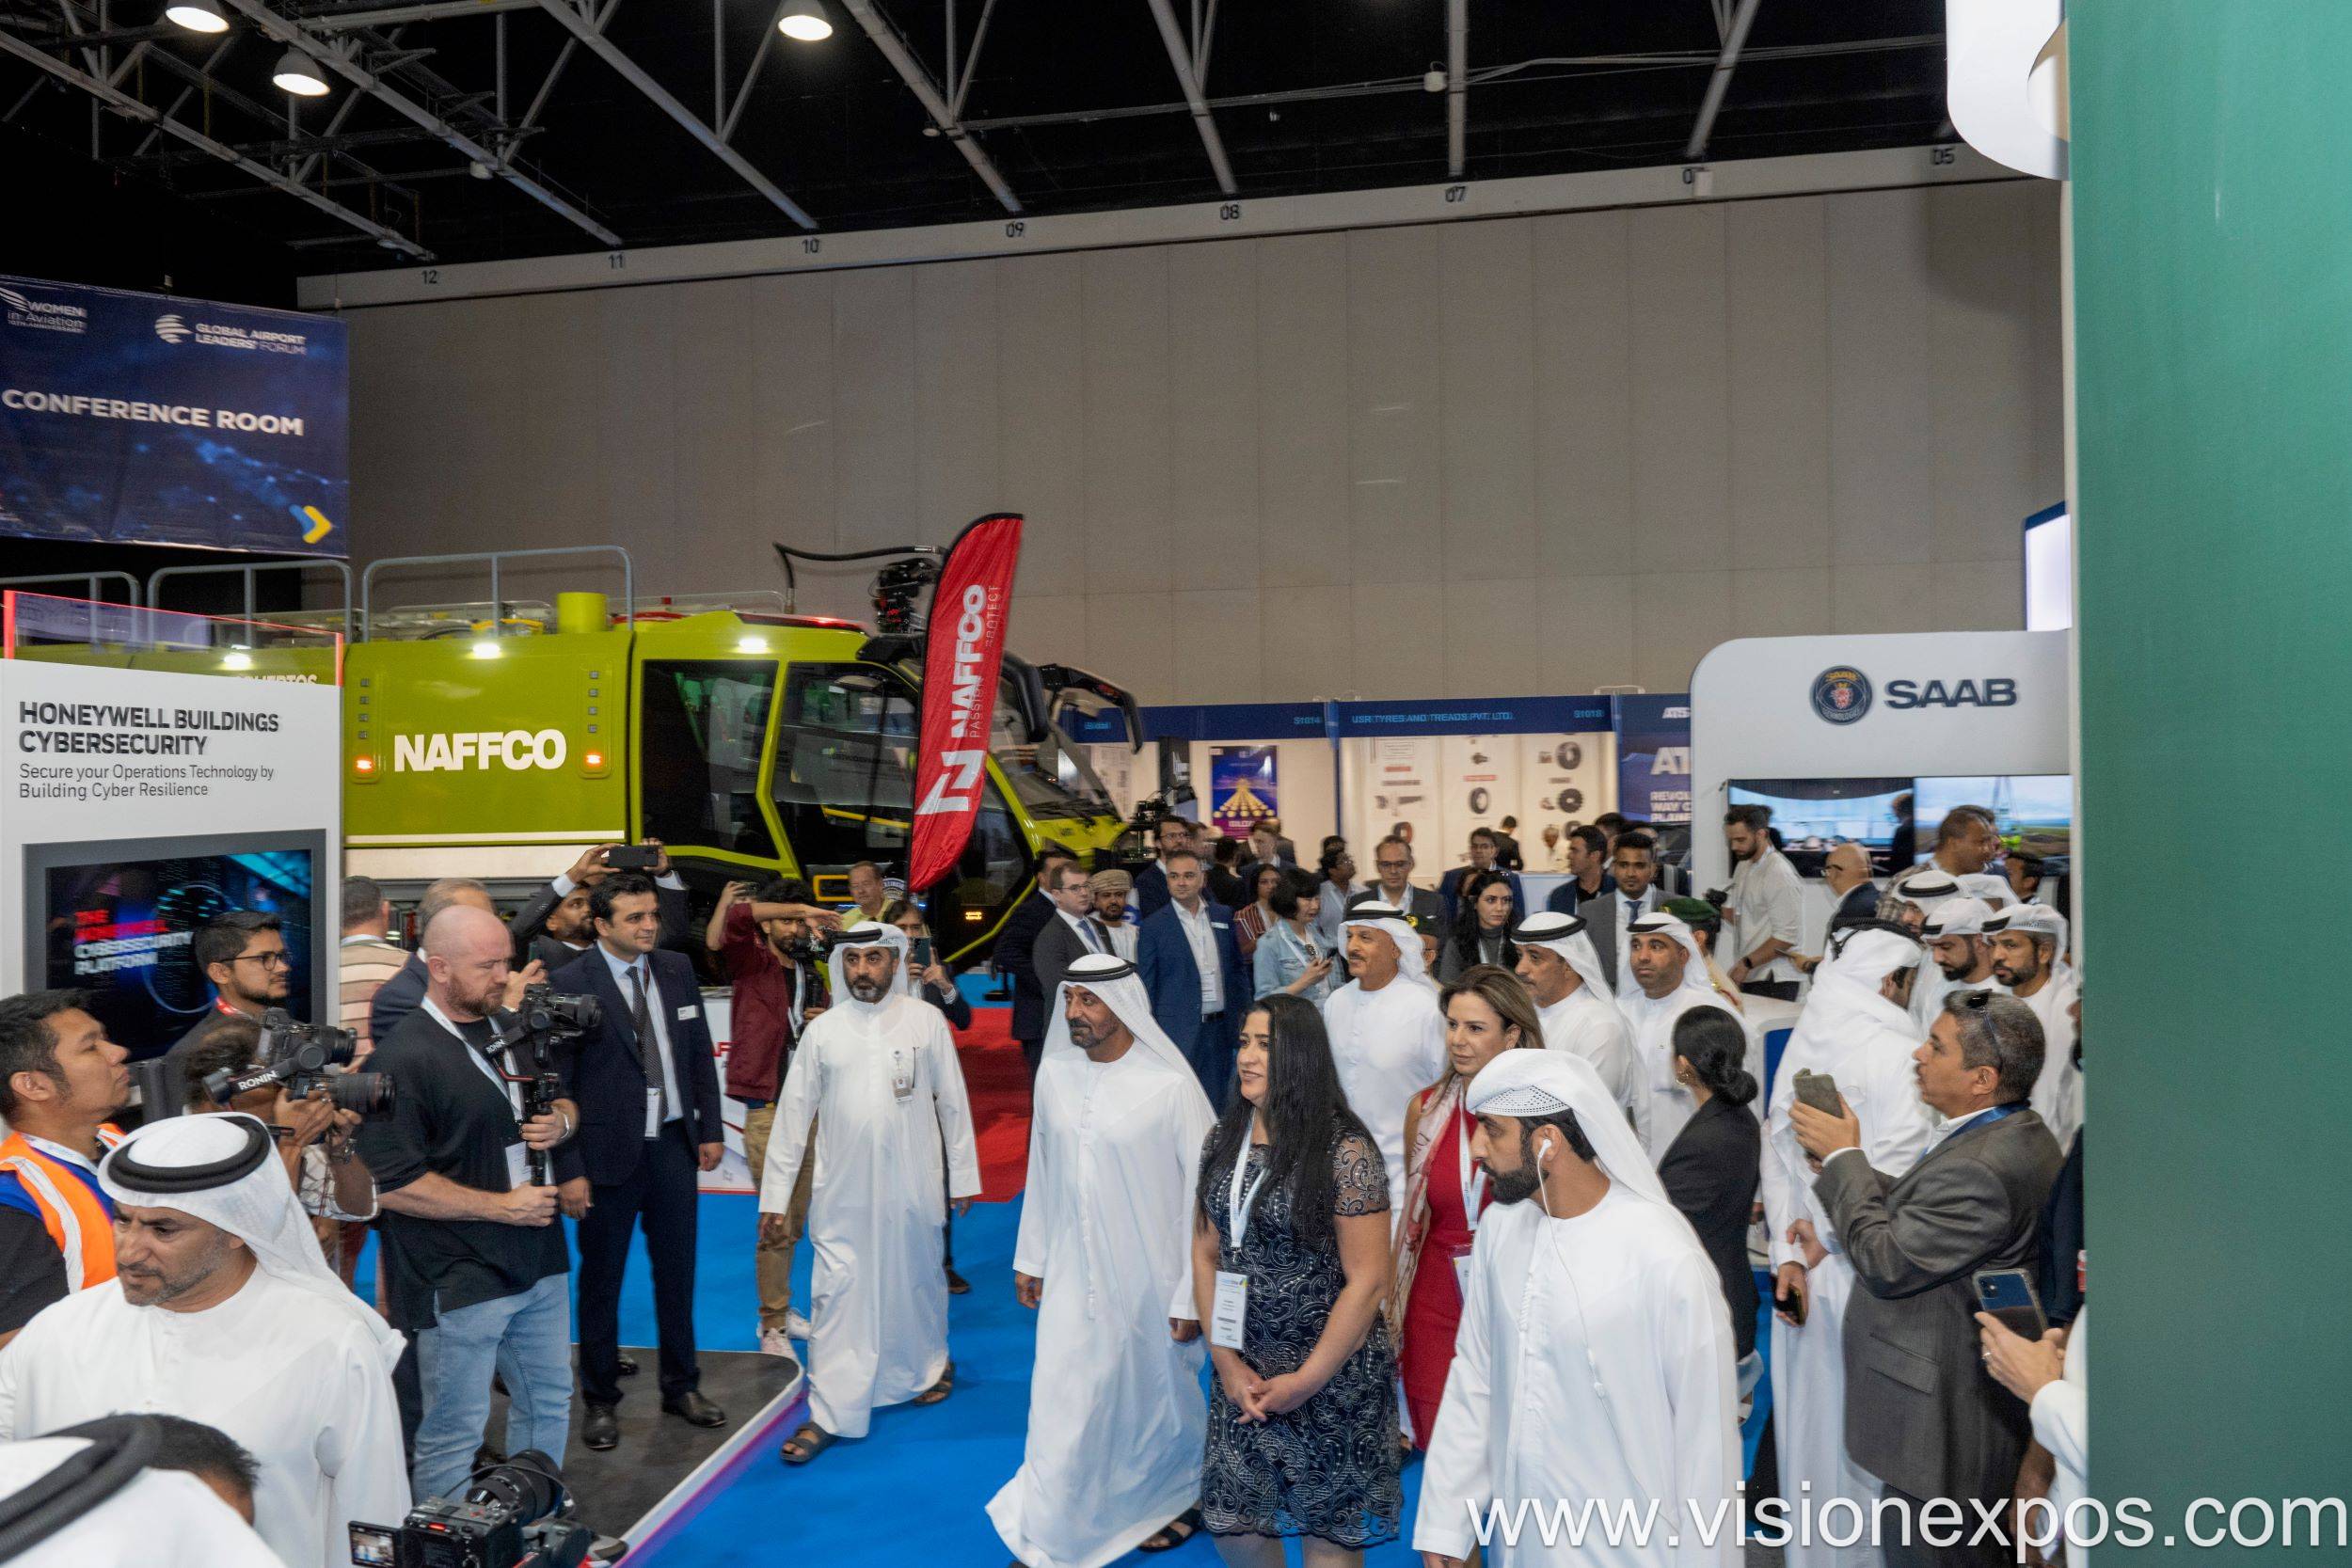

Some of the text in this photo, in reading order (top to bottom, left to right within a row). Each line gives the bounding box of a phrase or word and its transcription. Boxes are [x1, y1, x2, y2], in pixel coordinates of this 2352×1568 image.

[1445, 186, 1466, 202] 07
[1220, 204, 1239, 220] 08
[1007, 222, 1024, 237] 09
[802, 238, 819, 254] 10
[608, 254, 624, 269] 11
[421, 270, 437, 284] 12
[196, 324, 306, 345] GLOBAL AIRPORT
[259, 341, 307, 356] FORUM
[2, 388, 305, 436] CONFERENCE ROOM
[951, 584, 986, 738] NAFFCO
[1884, 678, 2020, 709] SAAB
[19, 701, 279, 733] HONEYWELL BUILDINGS
[1352, 715, 1372, 723] USR
[1375, 715, 1406, 723] TYRES
[1406, 714, 1427, 722] AND
[1429, 713, 1468, 722] TREADS
[19, 730, 208, 755] CYBERSECURITY
[394, 729, 566, 772] NAFFCO
[20, 763, 275, 782] Secure your Operations Technology by
[20, 782, 209, 800] Building Cyber Resilience
[238, 1069, 278, 1090] RONIN
